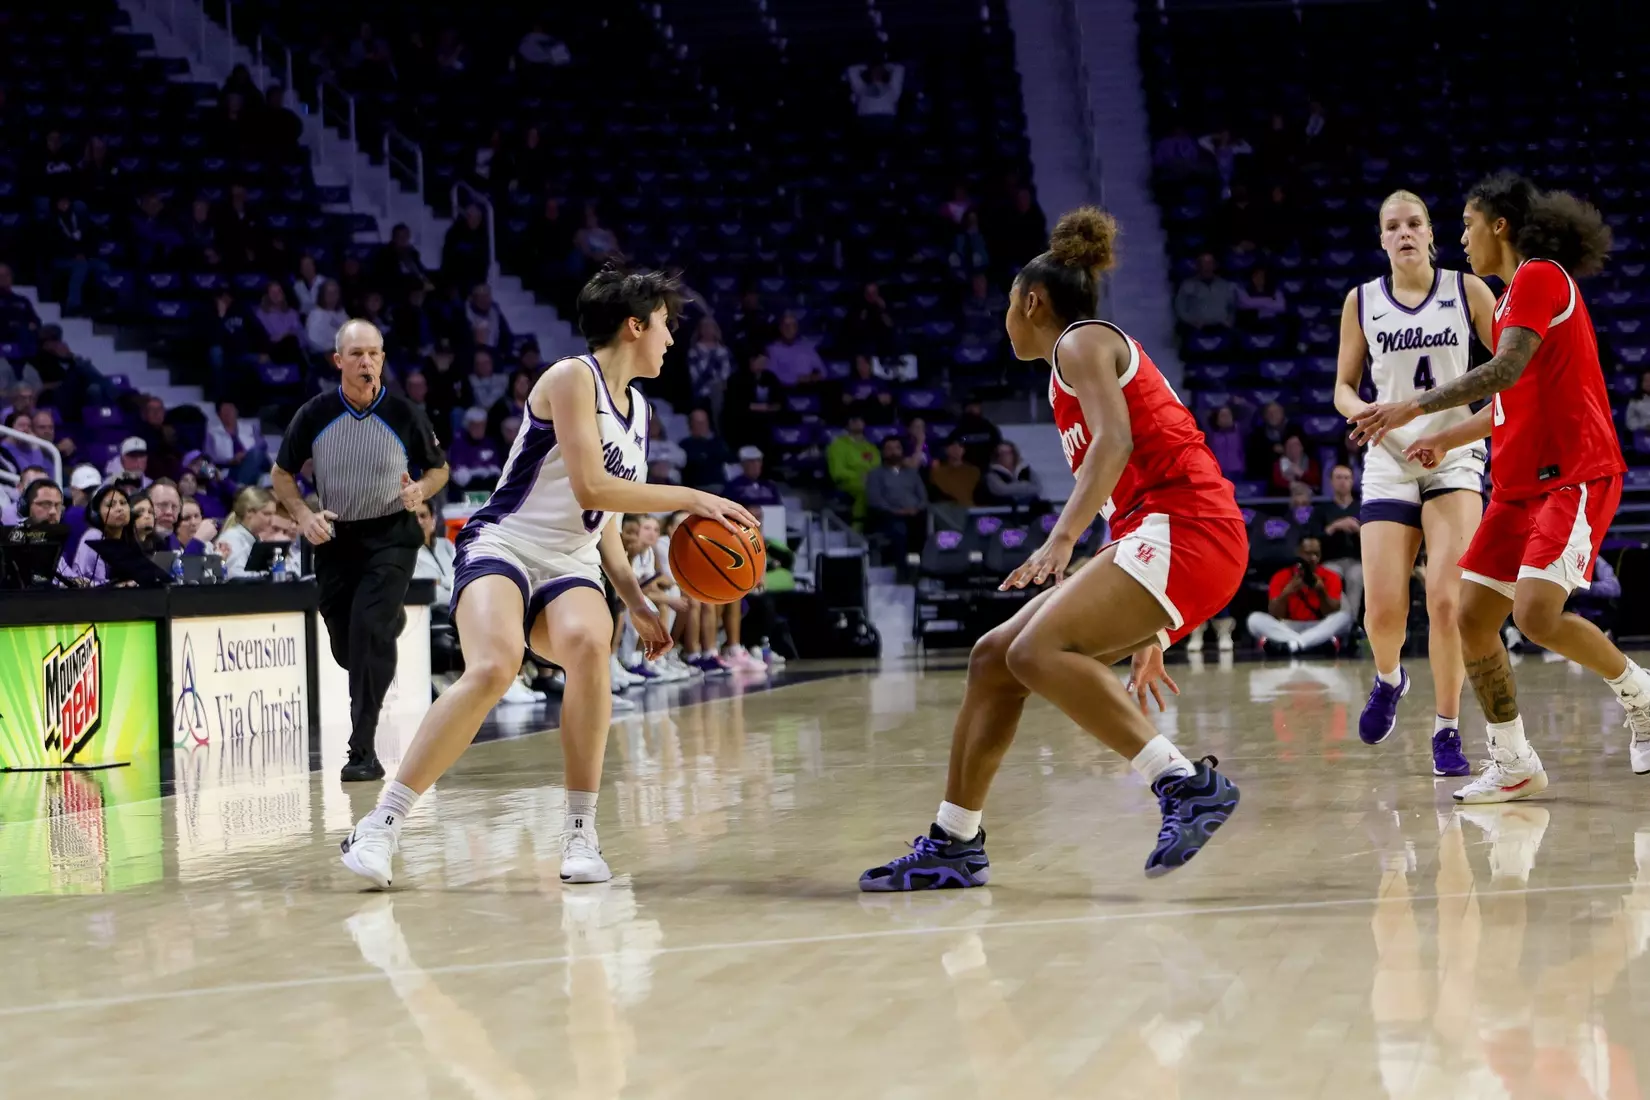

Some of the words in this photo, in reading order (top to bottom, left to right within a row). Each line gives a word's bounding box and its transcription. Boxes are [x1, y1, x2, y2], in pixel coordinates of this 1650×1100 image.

[1376, 326, 1459, 354] Wildcats
[1413, 354, 1437, 391] 4
[214, 622, 296, 672] Ascension
[215, 693, 244, 739] Via
[248, 685, 302, 736] Christi
